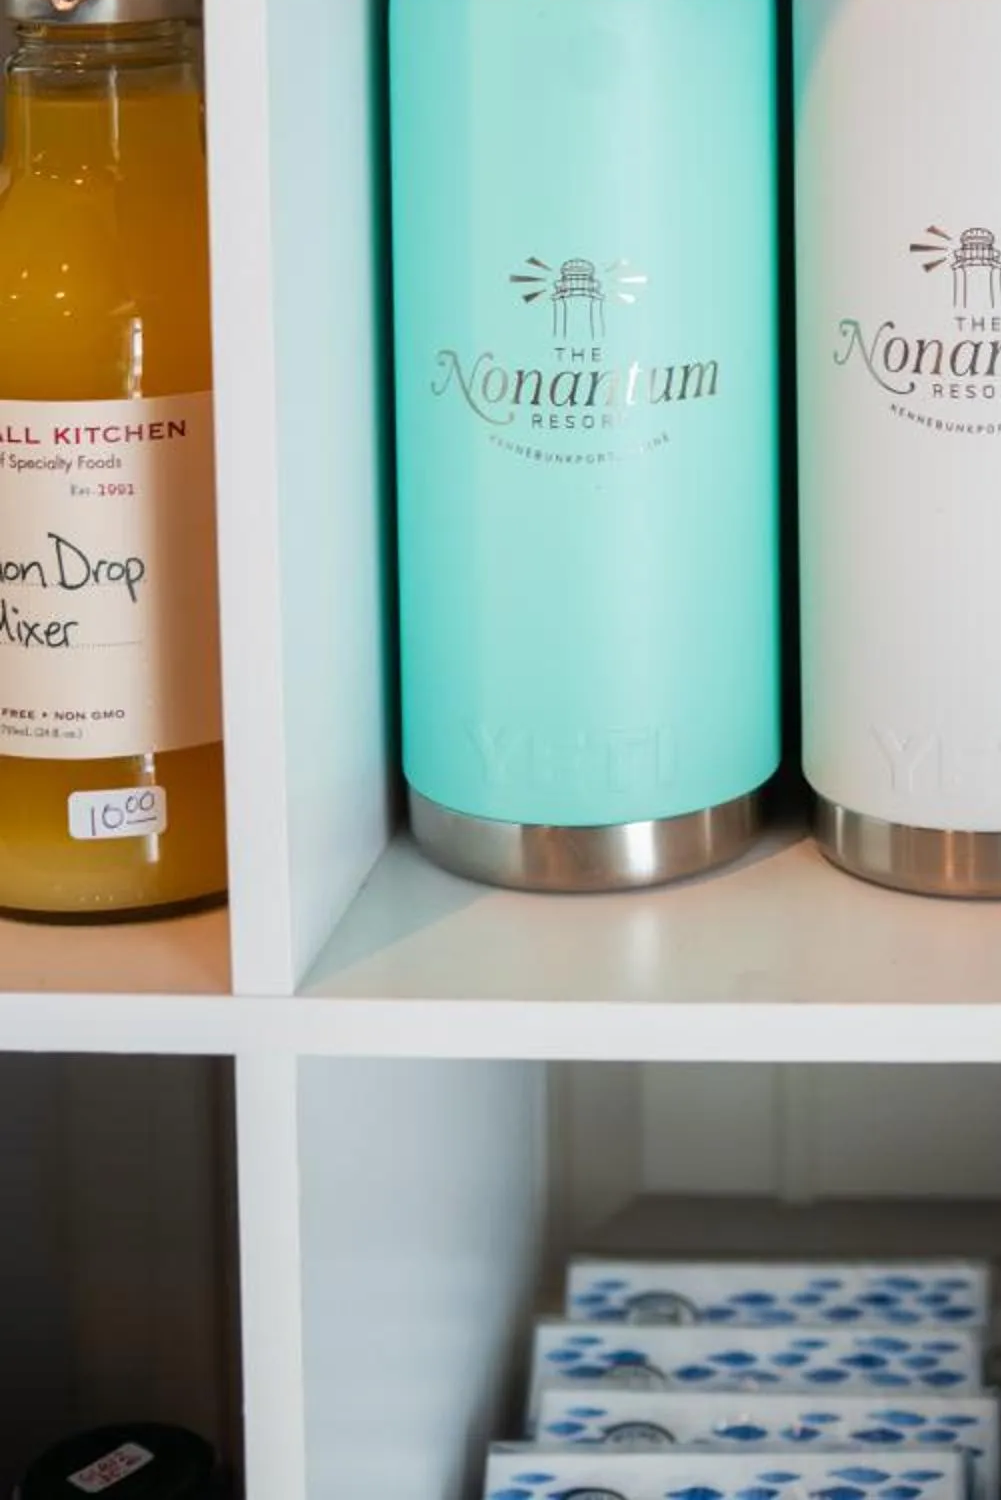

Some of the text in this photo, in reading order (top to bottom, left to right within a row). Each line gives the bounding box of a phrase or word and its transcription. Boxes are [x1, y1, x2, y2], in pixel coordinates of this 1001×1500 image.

[954, 316, 1001, 332] THE
[554, 347, 602, 362] THE
[430, 349, 719, 426] Nonantum
[532, 413, 620, 430] RESOR
[0, 419, 187, 445] LL KITCHEN
[9, 454, 73, 473] Specialty
[77, 455, 122, 469] Foods
[47, 531, 145, 603] Drop
[54, 710, 86, 722] NON
[91, 708, 125, 721] GMO
